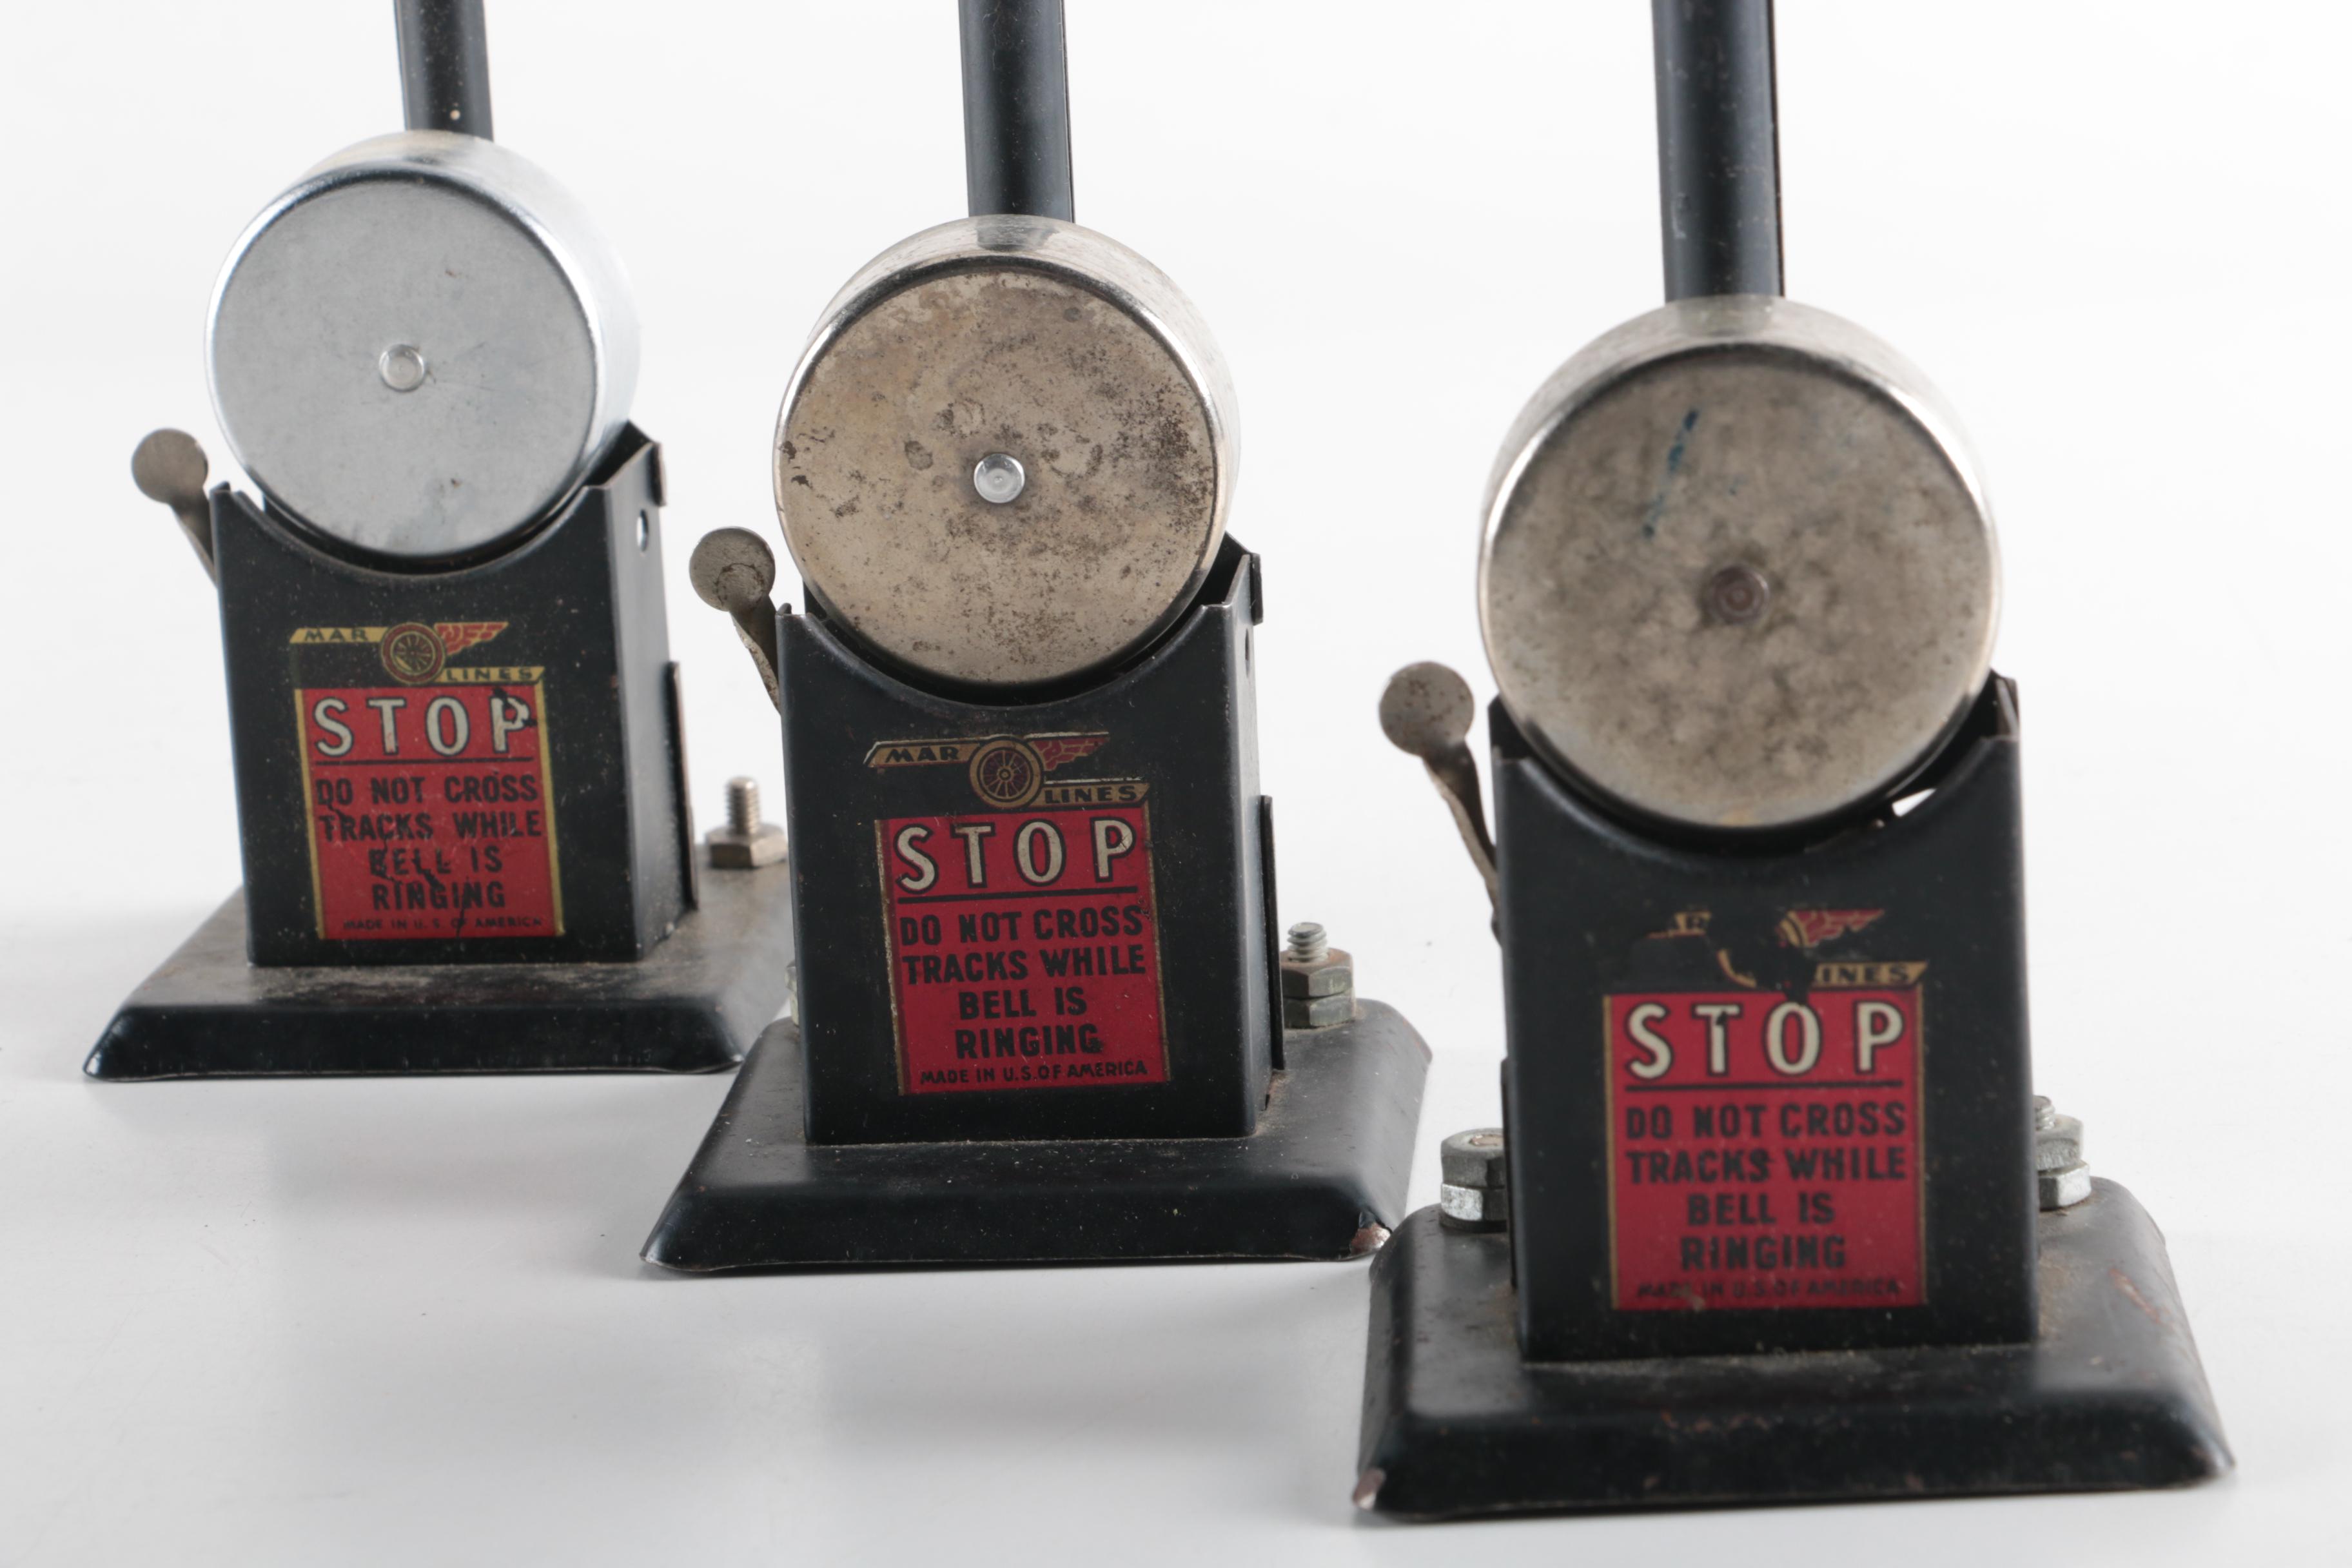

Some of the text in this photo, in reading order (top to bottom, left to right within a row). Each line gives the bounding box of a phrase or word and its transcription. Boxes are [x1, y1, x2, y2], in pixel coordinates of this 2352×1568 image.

[304, 628, 368, 642] MAR
[447, 668, 533, 681] LINES
[312, 695, 532, 757] STOP
[885, 745, 959, 763] MAR
[315, 774, 538, 805] DO NOT CROSS
[1045, 785, 1139, 804] LINES
[318, 810, 542, 841] TRACKS WHILE
[368, 846, 503, 876] BELL IS
[894, 816, 1137, 894] STOP
[373, 881, 506, 910] RINGING
[343, 919, 382, 930] MADE
[391, 919, 407, 930] IN
[475, 916, 542, 928] AMERICA
[899, 905, 1144, 946] DO NOT CROSS
[901, 945, 1146, 985] TRACKS WHILE
[959, 986, 1088, 1021] BELL IS
[956, 1024, 1104, 1060] RINGING
[1624, 999, 1906, 1081] STOP
[920, 1070, 969, 1084] MADE
[976, 1067, 995, 1083] IN
[1067, 1060, 1148, 1079] AMERICA
[1626, 1101, 1906, 1141] DO NOT CROSS
[1625, 1146, 1906, 1185] TRACKS WHILE
[1687, 1191, 1836, 1226] BELL IS
[1681, 1235, 1847, 1271] RINGING
